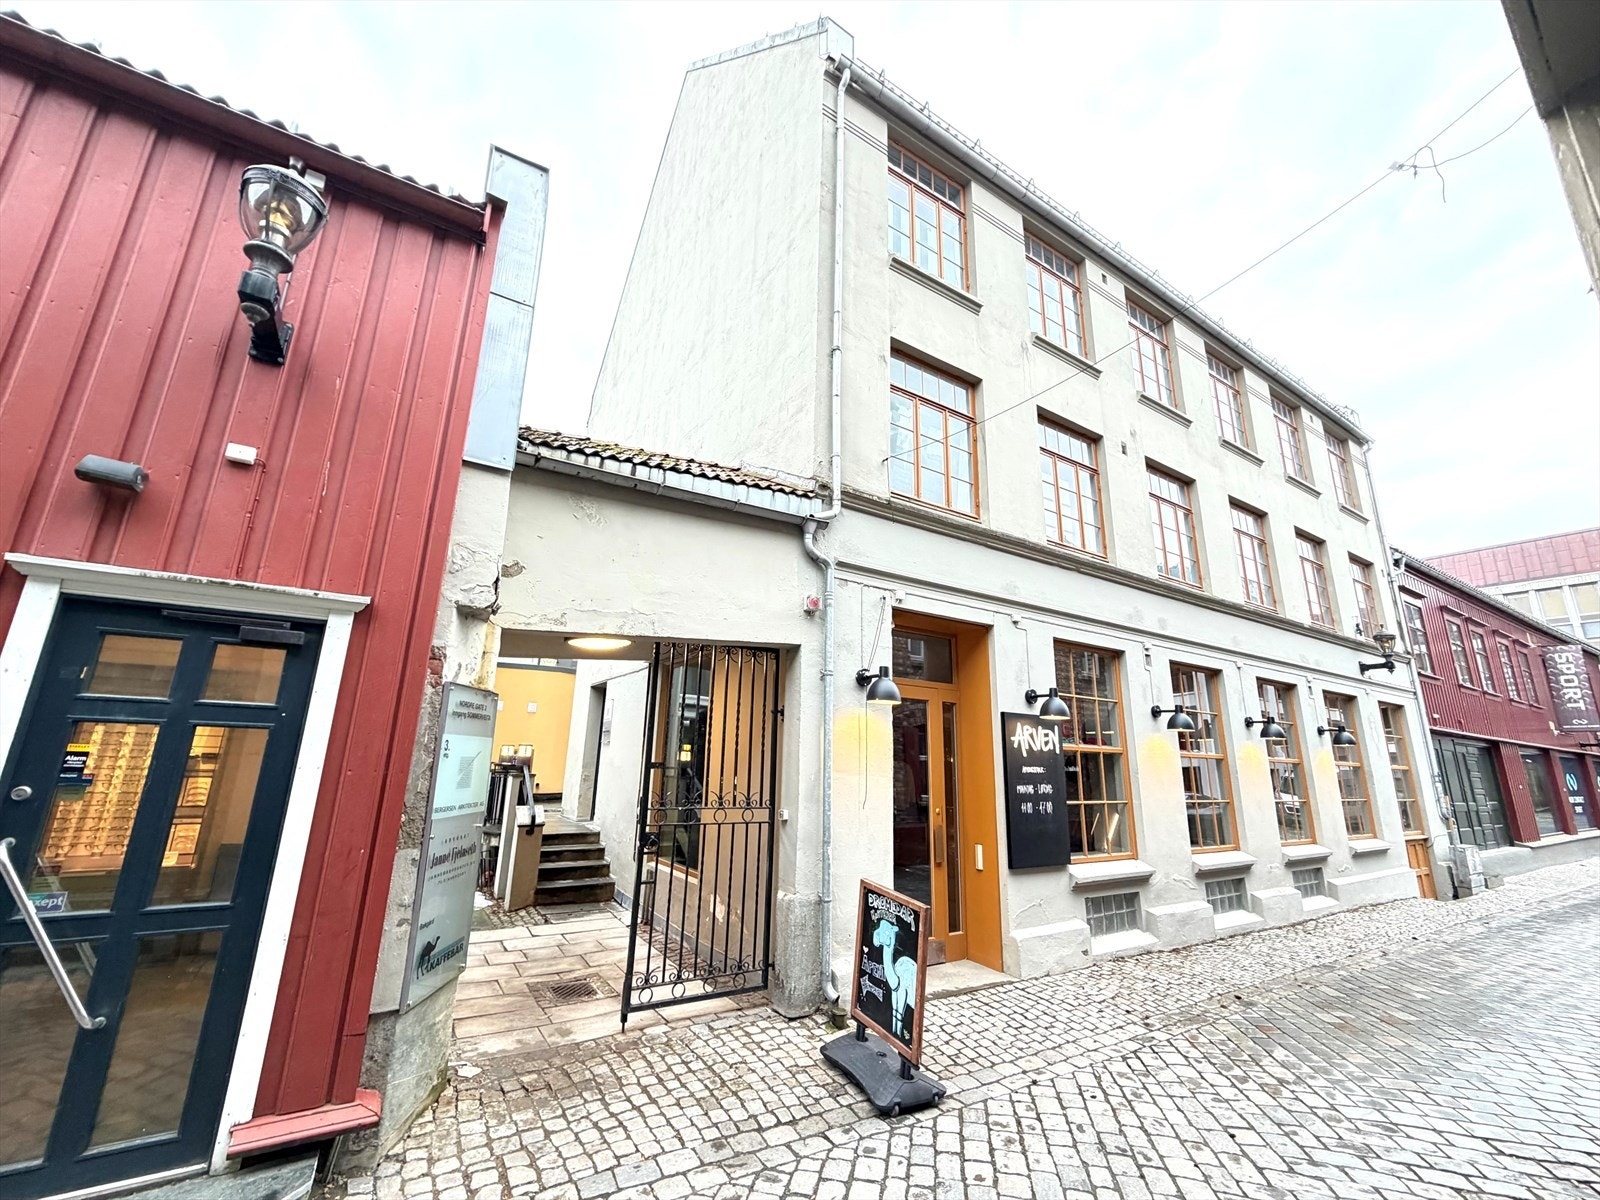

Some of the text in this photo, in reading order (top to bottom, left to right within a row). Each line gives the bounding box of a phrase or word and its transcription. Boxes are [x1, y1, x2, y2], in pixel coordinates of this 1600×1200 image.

[1554, 652, 1586, 711] SPORT
[1010, 721, 1060, 758] ARVEN
[868, 893, 916, 932] DROMEDAR
